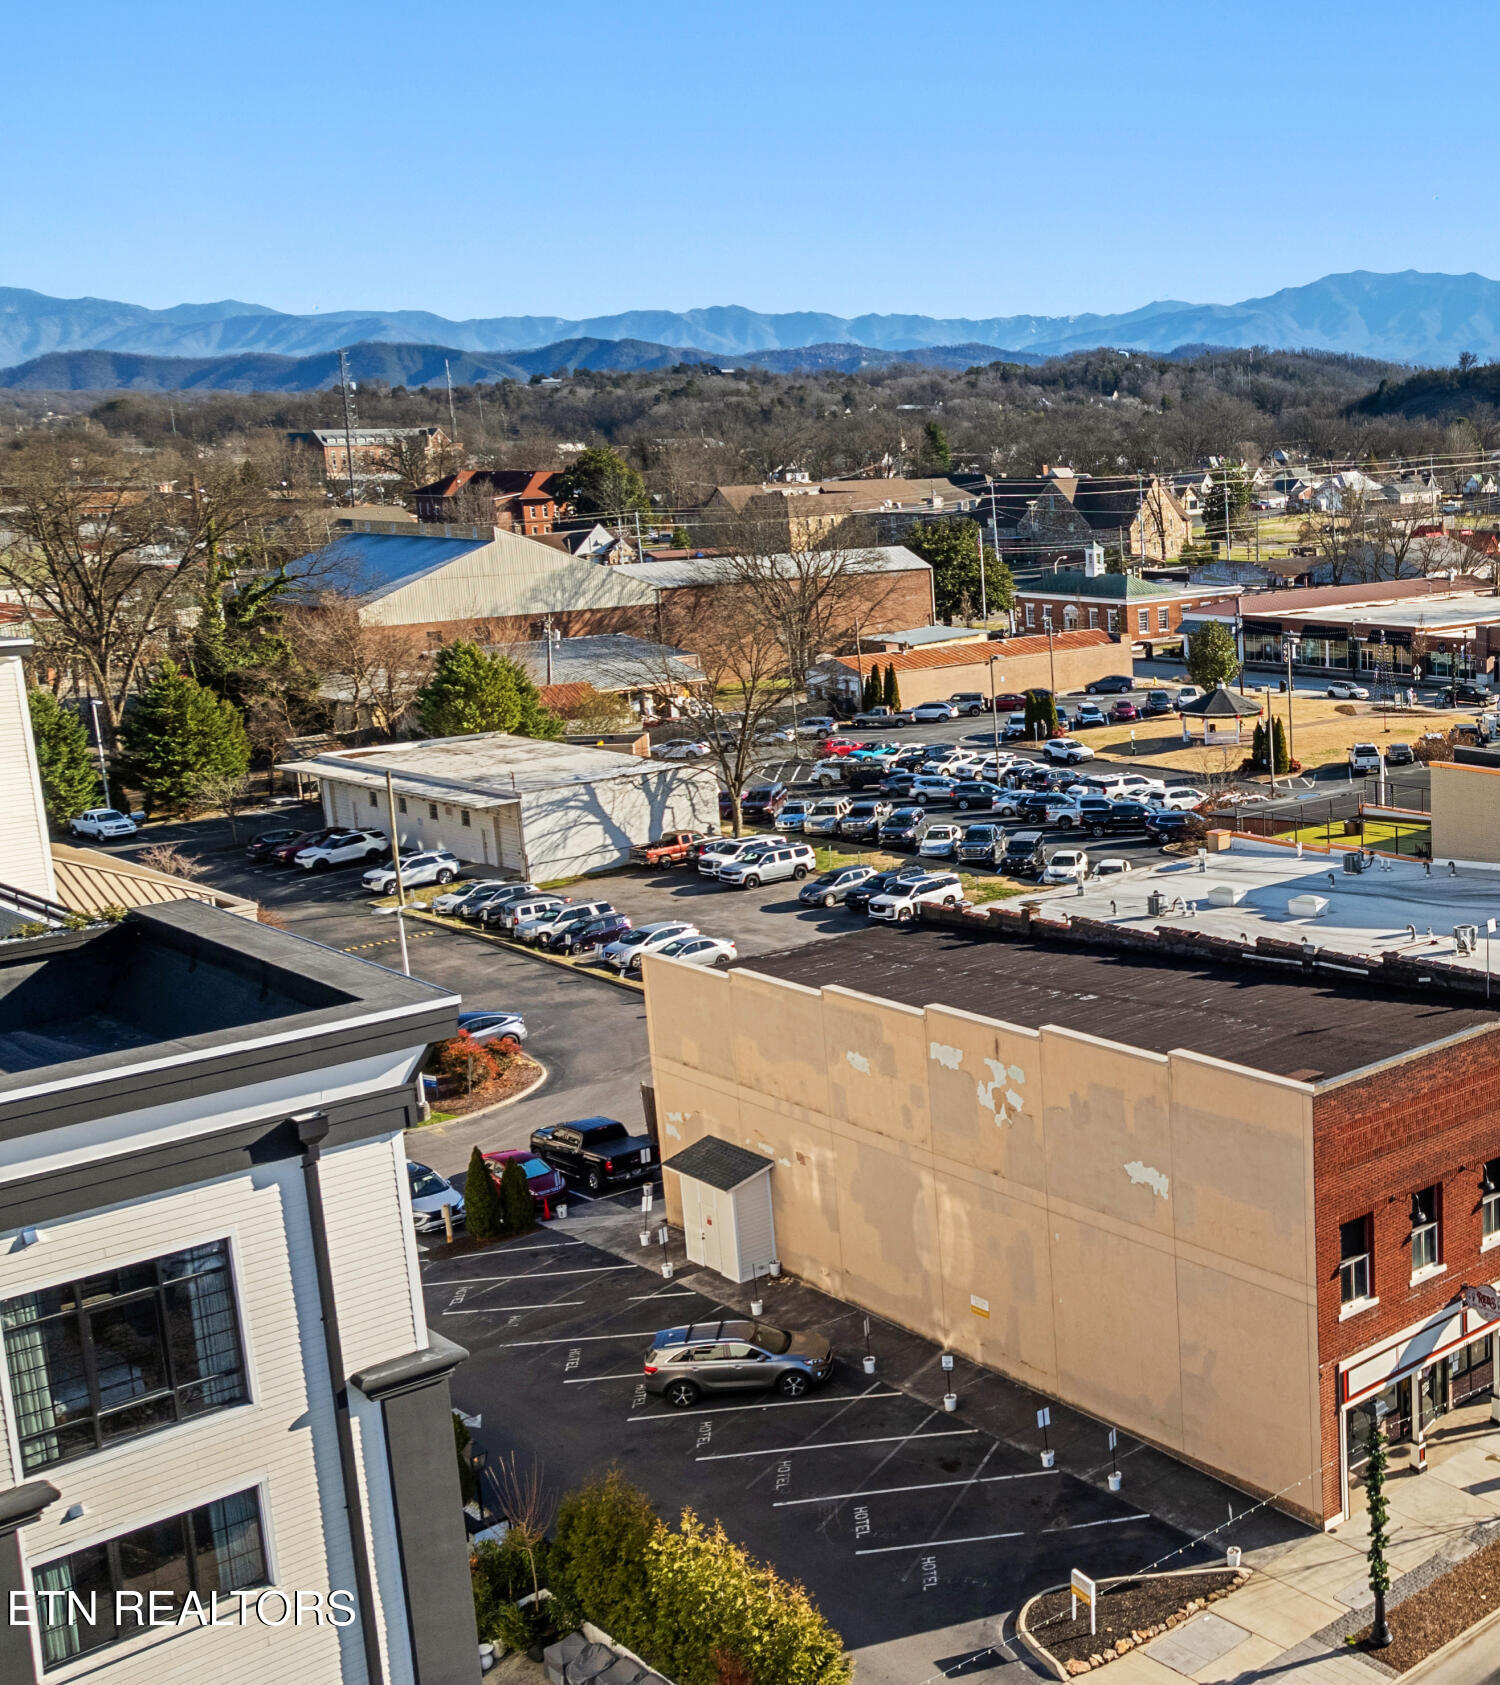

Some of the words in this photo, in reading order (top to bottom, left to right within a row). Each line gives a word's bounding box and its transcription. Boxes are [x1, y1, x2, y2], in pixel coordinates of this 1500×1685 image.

[565, 1348, 582, 1372] HOTEL
[631, 1384, 647, 1409] HOTEL
[696, 1421, 713, 1448] HOTEL
[775, 1460, 792, 1491] HOTEL
[853, 1506, 870, 1539] HOTEL
[921, 1556, 937, 1591] HOTEL
